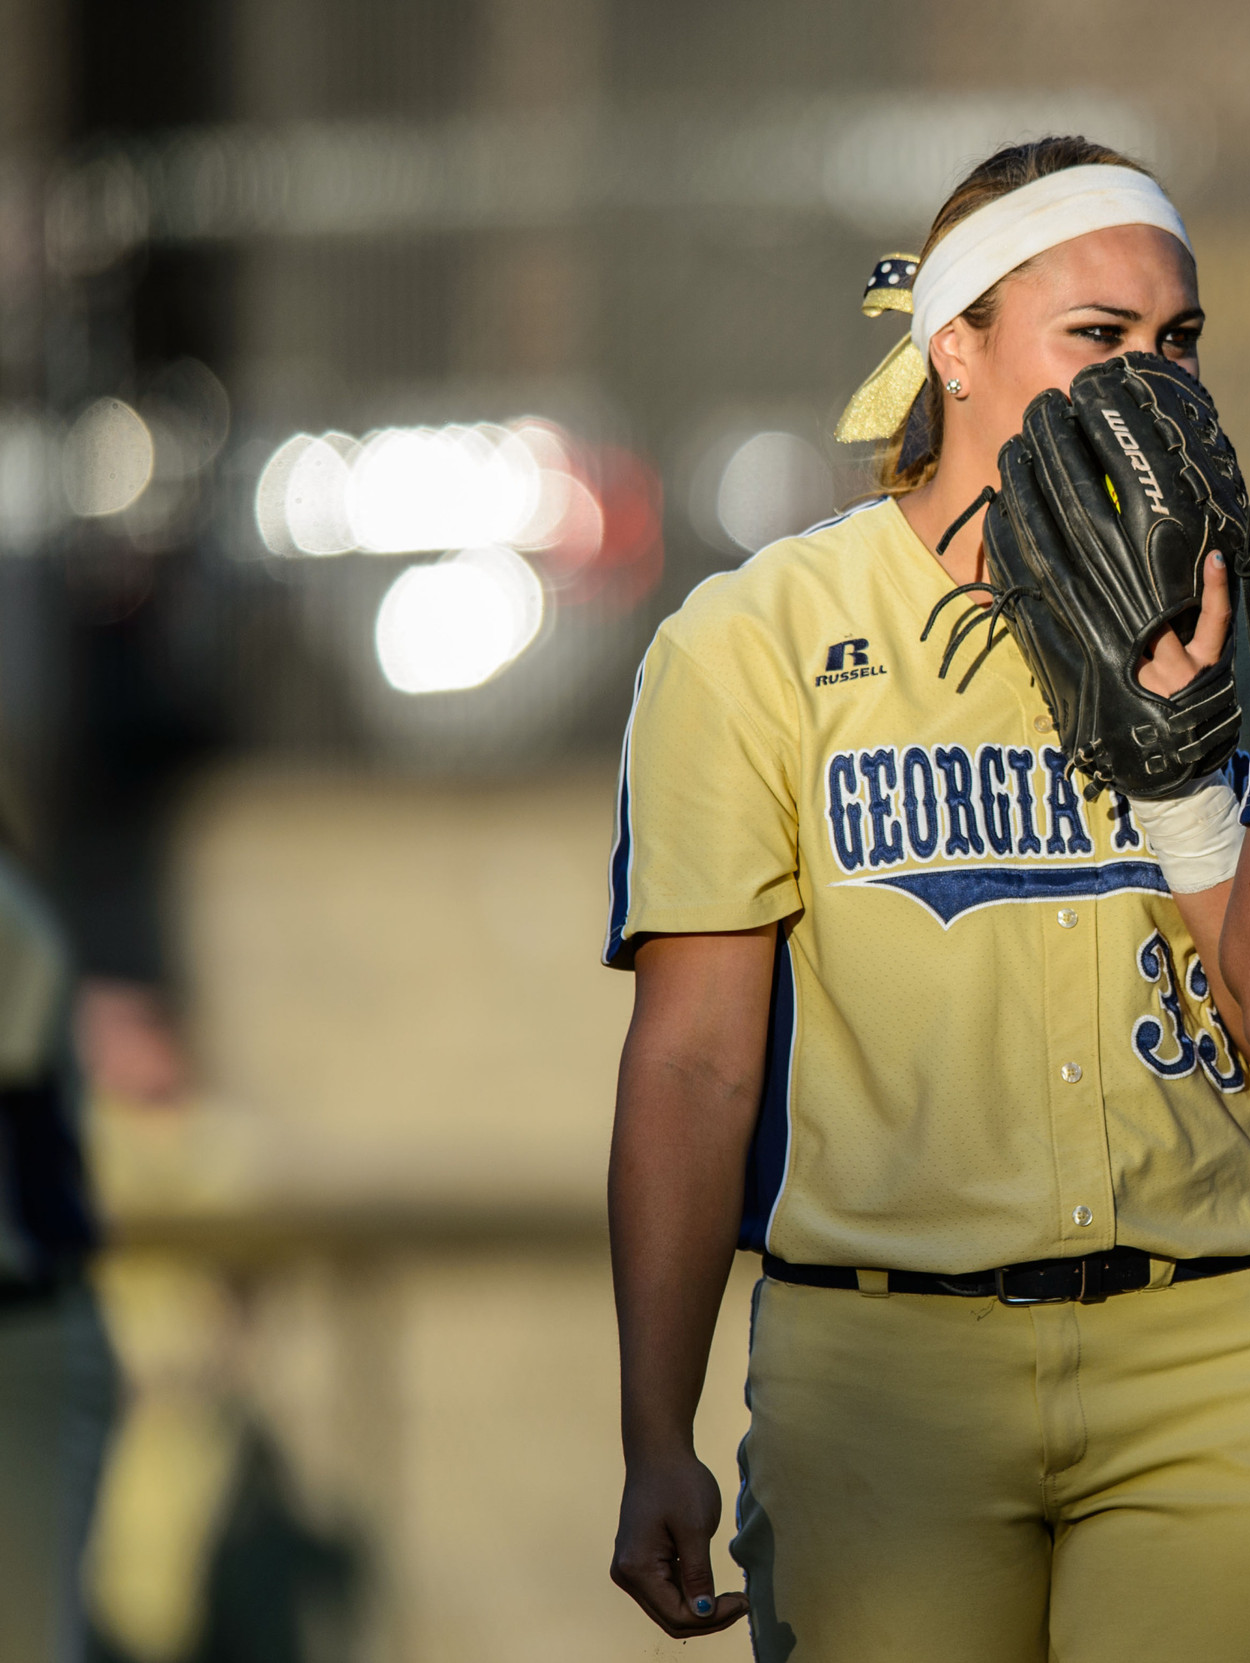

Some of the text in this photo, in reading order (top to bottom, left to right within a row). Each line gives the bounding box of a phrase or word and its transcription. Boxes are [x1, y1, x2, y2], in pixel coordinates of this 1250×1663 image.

[1101, 409, 1170, 516] WORTH
[815, 664, 888, 688] RUSSELL
[826, 638, 870, 673] R
[825, 743, 1096, 875] GEORGIA
